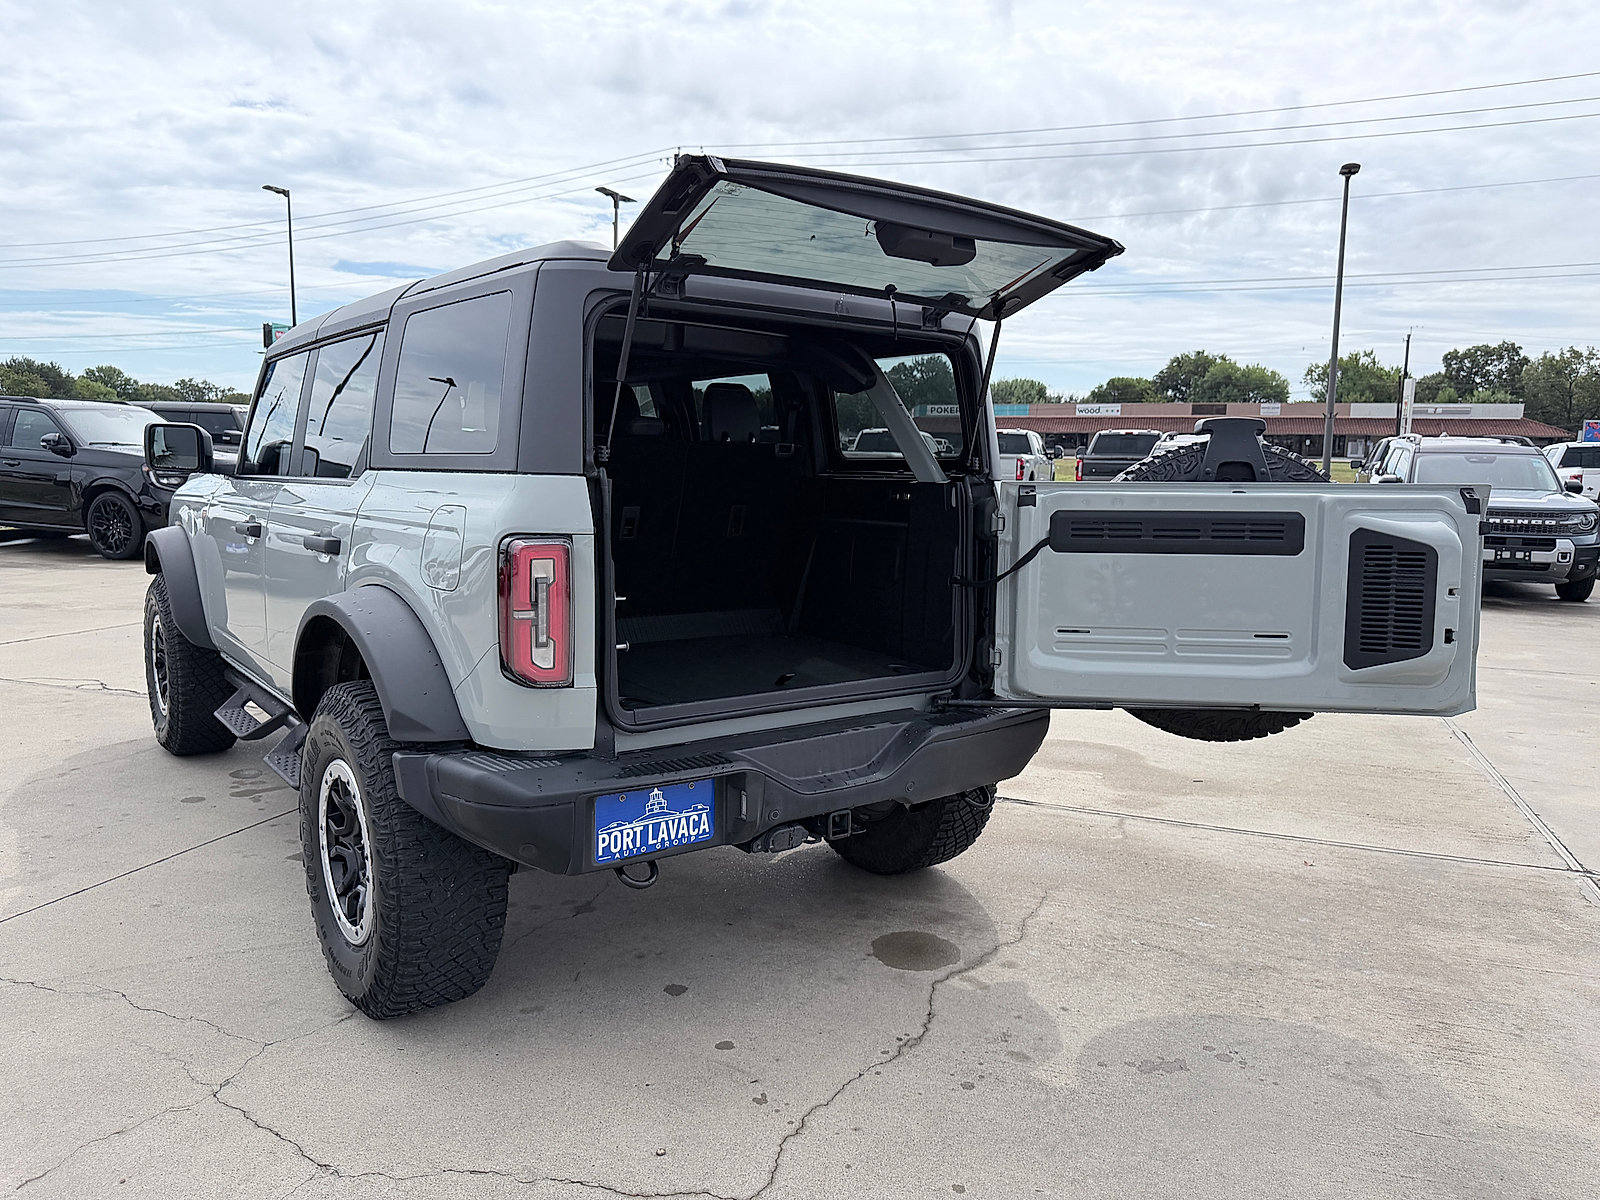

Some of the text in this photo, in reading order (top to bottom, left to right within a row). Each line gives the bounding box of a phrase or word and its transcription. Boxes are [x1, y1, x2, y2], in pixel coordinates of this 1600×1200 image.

[1489, 518, 1557, 526] RONCO
[598, 812, 710, 857] PORT LAVACA
[614, 835, 696, 860] AUTO GROUP
